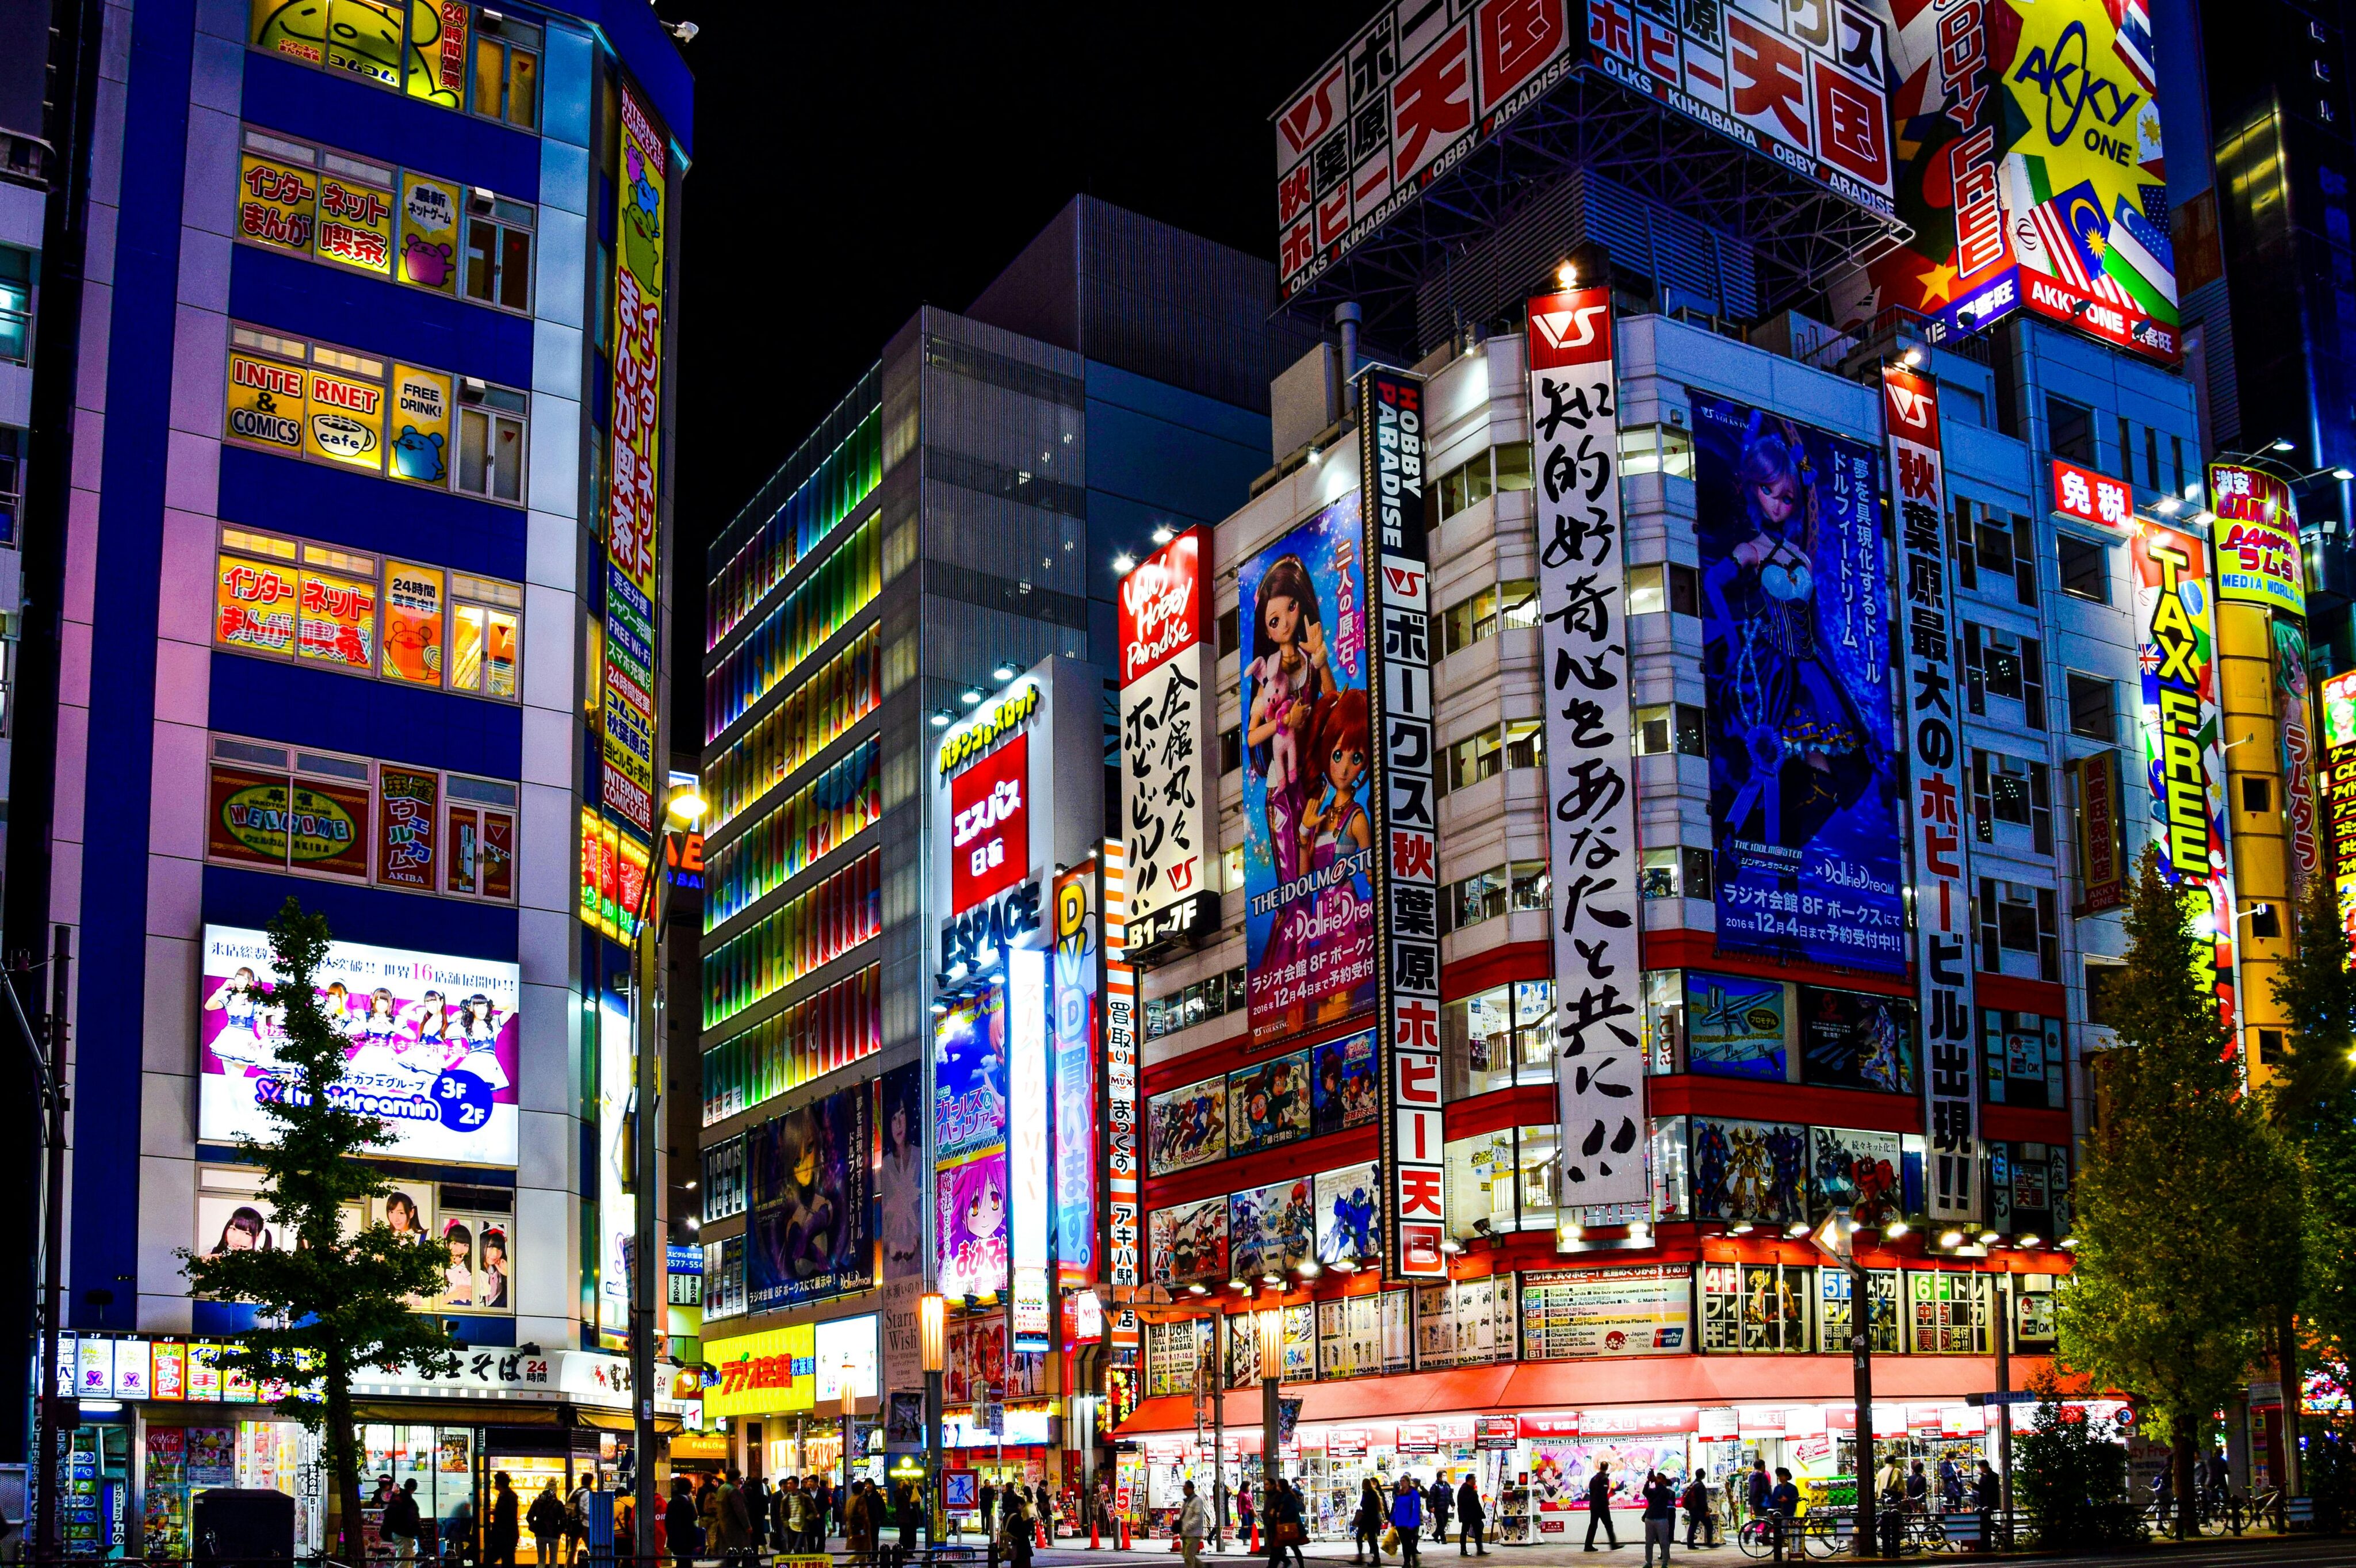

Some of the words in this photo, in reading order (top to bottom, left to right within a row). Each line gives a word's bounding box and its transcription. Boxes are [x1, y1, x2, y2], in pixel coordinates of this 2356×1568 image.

[440, 2, 466, 91] 24時間営業
[328, 53, 396, 85] コムコム
[1592, 49, 1652, 94] VOLKS
[1657, 84, 1757, 148] AKIHABARA
[1760, 136, 1817, 178] HOBBY
[1819, 166, 1895, 217] PARADISE
[1331, 180, 1417, 264] AKIHABARA
[1421, 130, 1479, 189] HOBBY
[1482, 52, 1571, 137] PARADISE
[2084, 128, 2132, 167] ONE
[244, 165, 313, 203] インター
[321, 182, 389, 225] ネット
[415, 186, 446, 207] 最新
[1949, 125, 2004, 280] FREE
[408, 201, 452, 227] ネットゲーム
[243, 203, 311, 246] まんが
[320, 221, 388, 267] 喫茶
[2031, 281, 2086, 318] AKKY
[2086, 305, 2125, 335] ONE
[255, 391, 277, 415] &
[403, 383, 440, 403] FREE
[400, 398, 442, 418] DRINK!
[230, 407, 301, 448] COMICS
[1716, 415, 1738, 429] VOLKS
[318, 429, 361, 451] cafe
[1398, 386, 1421, 499] HOBBY
[1377, 381, 1402, 549] PARADISE
[2216, 470, 2250, 496] 激安
[2060, 471, 2127, 527] 免税
[1852, 457, 1881, 685] 夢を具現化するドール
[223, 564, 294, 604] インター
[302, 577, 371, 620] ネット
[392, 577, 437, 599] 24時間
[614, 571, 648, 617] 完全分煙
[2221, 574, 2263, 591] MEDIA
[2267, 580, 2295, 601] WORLD
[392, 593, 435, 615] 営業中!
[2148, 544, 2200, 686] TAX
[609, 592, 652, 644] シャワー完備
[220, 605, 292, 648] まんが
[299, 619, 371, 664] 喫茶
[609, 616, 630, 648] FREE
[632, 641, 651, 667] Wi-Fi
[607, 665, 651, 714] 24時間営業
[607, 690, 651, 739] コムコム
[606, 710, 651, 764] 秋葉原店
[940, 686, 1037, 773] パチンコ&スロット
[382, 774, 437, 804] 麻雀
[604, 764, 649, 805] INTERNET
[2159, 689, 2211, 875] FREE
[267, 789, 314, 807] 麻雀
[231, 805, 350, 843] WELCOME
[954, 779, 1022, 848] エスパス
[294, 842, 330, 854] AKIBA
[388, 800, 433, 870] ウェルカム
[1734, 839, 1750, 851] THE
[388, 871, 424, 884] AKIBA
[1252, 888, 1279, 917] THE
[1723, 883, 1798, 913] ラジオ会館
[1802, 896, 1823, 916] 8F
[1827, 900, 1900, 927] ボークスにて
[2089, 884, 2117, 900] AKKY
[2091, 895, 2114, 909] ONE
[941, 881, 1041, 973] ESPACE
[211, 942, 268, 961] 来店総数
[1252, 958, 1307, 995] ラジオ会館
[1309, 951, 1327, 974] 8F
[1108, 1001, 1132, 1066] 買取り
[2026, 1062, 2040, 1073] OK
[441, 1077, 467, 1100] 3F
[459, 1103, 485, 1125] 2F
[937, 1085, 988, 1122] ガールズ
[938, 1113, 998, 1144] パンツァー
[1181, 1146, 1201, 1162] PRIME
[1852, 1140, 1896, 1153] 続々キット化!!
[941, 1175, 952, 1289] 魔法もあるんだよ
[885, 1282, 920, 1300] 水瀬いのり
[1705, 1267, 1737, 1293] 4F
[1823, 1273, 1852, 1298] 5F
[1916, 1276, 1949, 1299] 6F
[749, 1288, 773, 1304] ラジオ会館
[775, 1286, 783, 1298] 8F
[1527, 1290, 1540, 1298] 6F
[1527, 1299, 1540, 1309] 5F
[886, 1309, 919, 1330] Starry
[1527, 1309, 1541, 1318] 4F
[1527, 1320, 1541, 1328] 3F
[889, 1328, 917, 1352] Wish
[1528, 1329, 1542, 1338] 2F
[1655, 1332, 1682, 1340] UnionPay
[2038, 1322, 2050, 1333] OK
[1152, 1337, 1165, 1345] FULL
[1152, 1345, 1158, 1353] IN
[1529, 1340, 1540, 1348] 1F
[1529, 1349, 1540, 1358] B1
[526, 1360, 548, 1373] 24
[526, 1372, 547, 1383] 時間
[721, 1353, 793, 1397] ラジオ会館
[790, 1355, 814, 1378] 秋葉原
[656, 1376, 666, 1387] 24
[656, 1387, 665, 1397] 時間
[2147, 1444, 2171, 1457] Free
